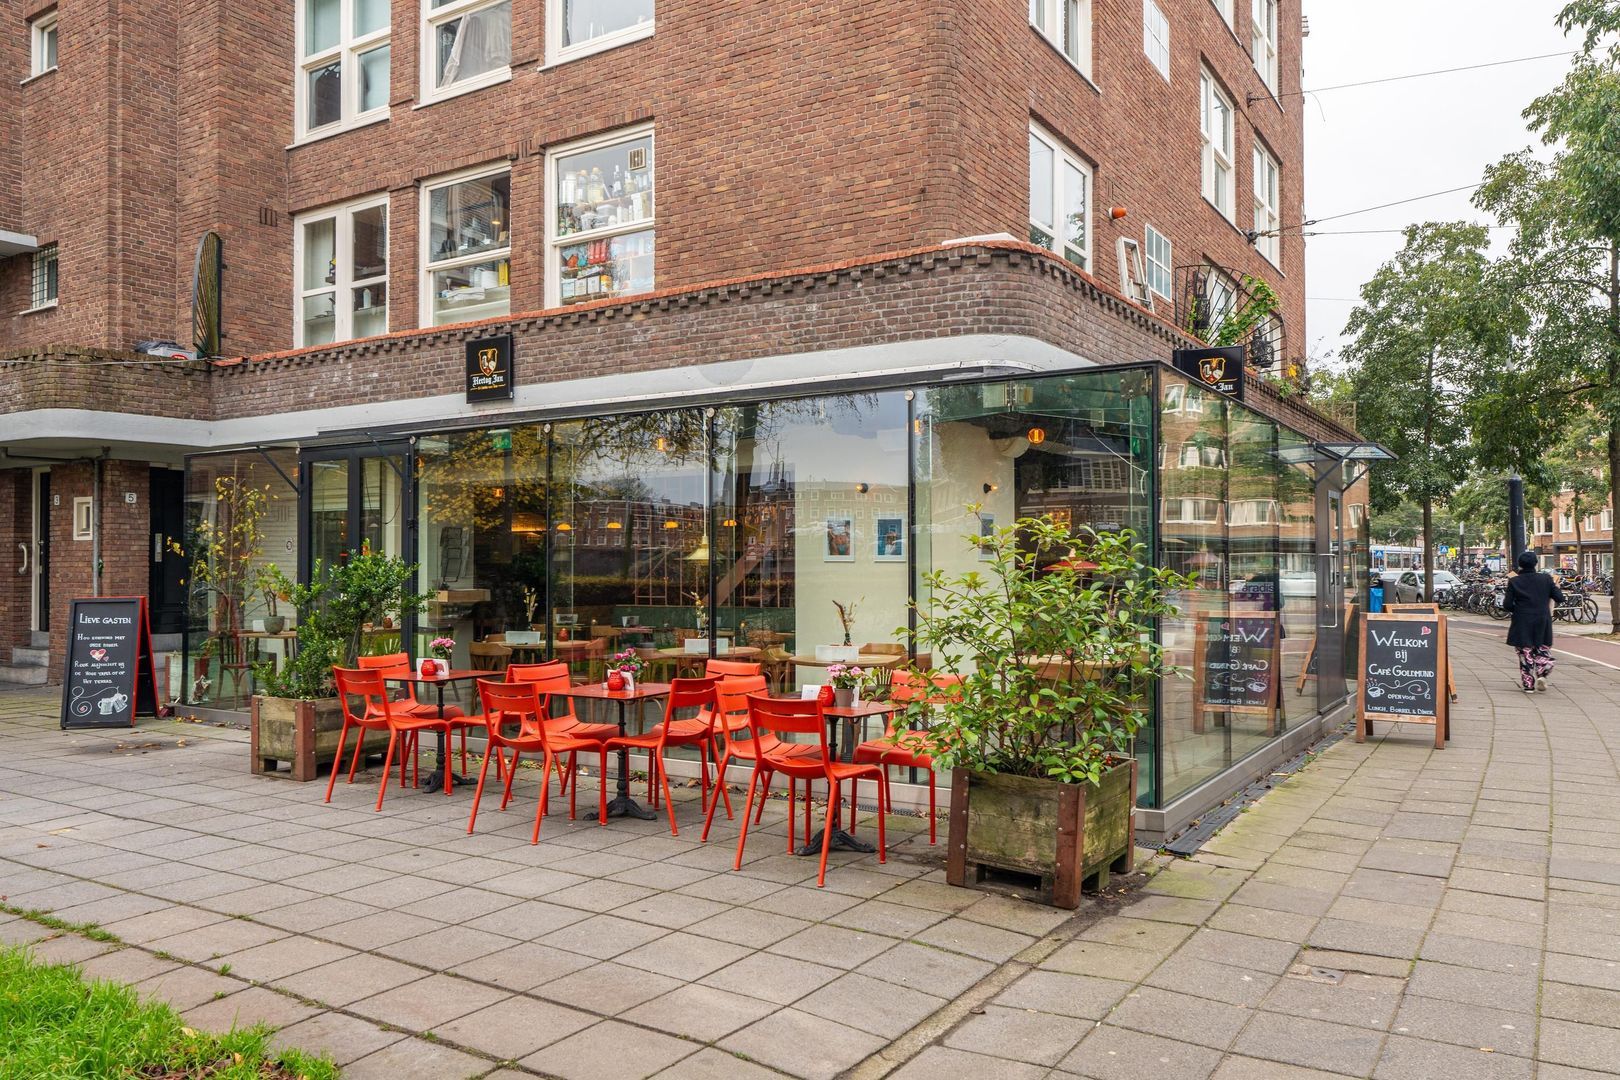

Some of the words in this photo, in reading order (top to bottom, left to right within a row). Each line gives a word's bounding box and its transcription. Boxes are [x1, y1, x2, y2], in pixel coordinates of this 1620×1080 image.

[492, 374, 503, 385] Jan
[1371, 630, 1428, 648] WELKOM
[1392, 665, 1435, 678] GOLDMUND
